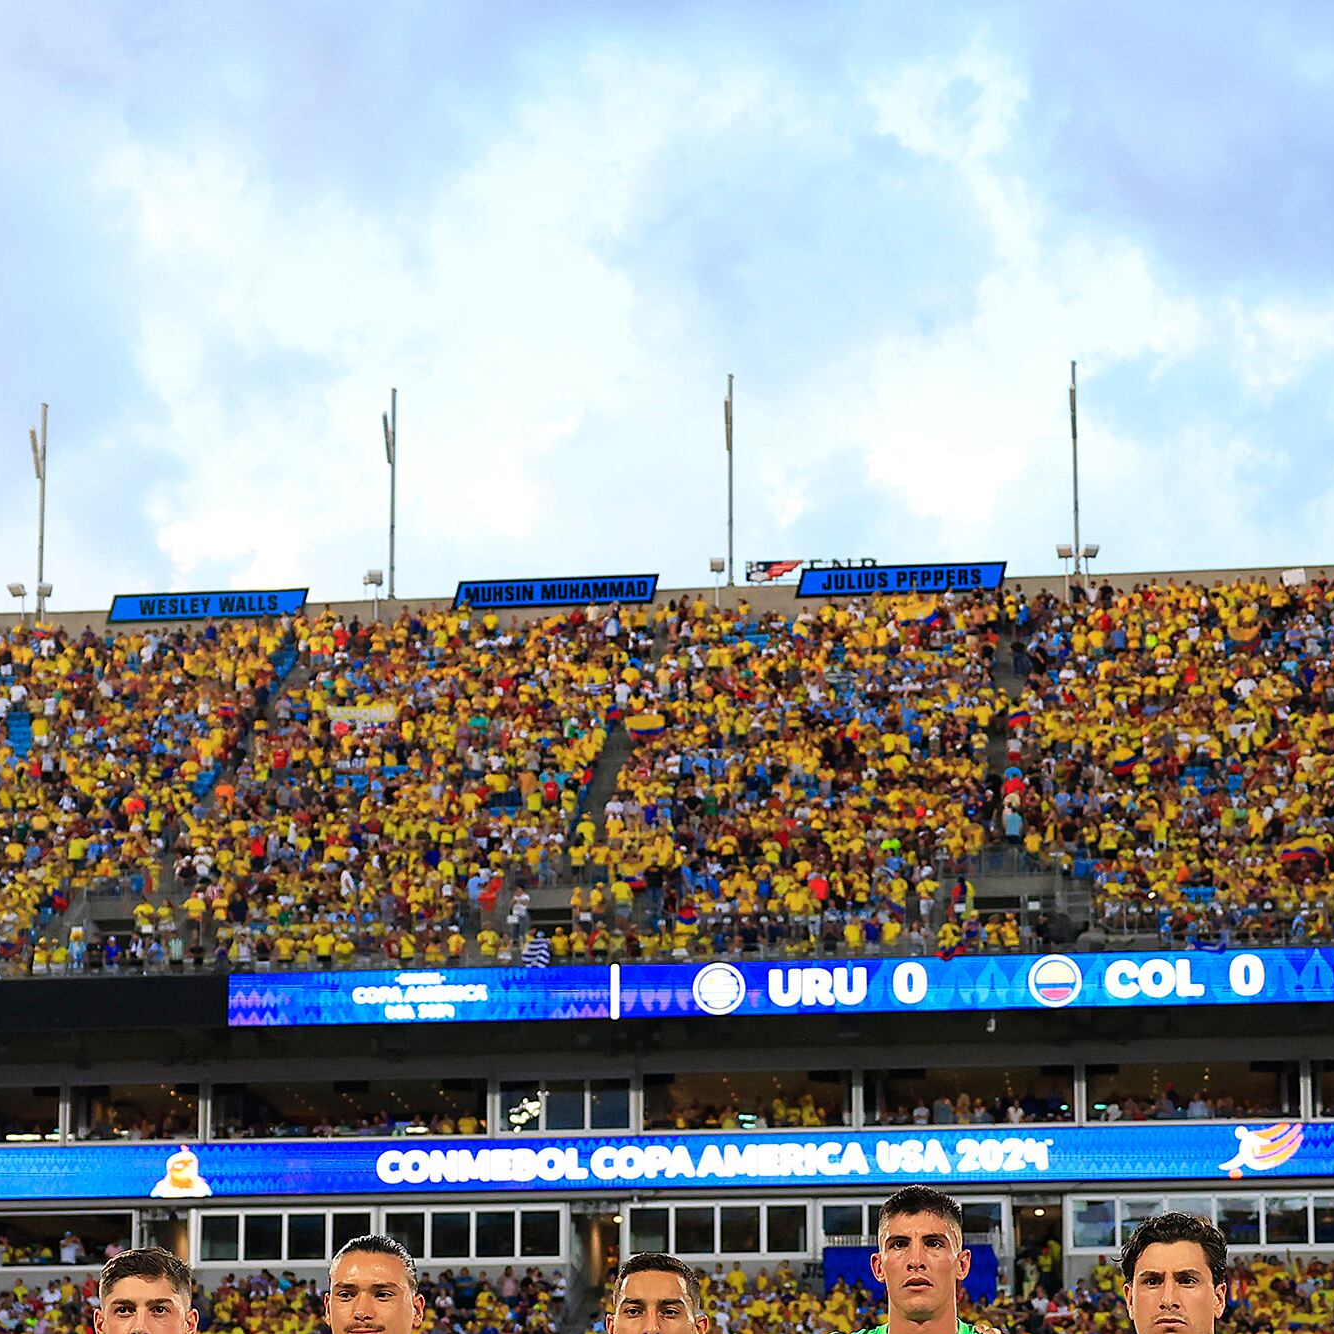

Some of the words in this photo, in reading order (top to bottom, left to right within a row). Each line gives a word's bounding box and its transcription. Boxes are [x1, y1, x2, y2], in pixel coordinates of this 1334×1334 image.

[464, 584, 535, 602] MUHSIN
[540, 579, 648, 600] MUHAMMAD
[821, 570, 889, 591] JULIUS
[896, 568, 982, 589] PEPPERS
[139, 597, 210, 616] WESLEY
[218, 594, 278, 613] WALLS
[767, 966, 868, 1007] URU
[892, 961, 928, 1004] 0
[1104, 957, 1205, 998] COL
[1228, 953, 1266, 996] 0
[352, 984, 403, 1004] COPA
[403, 983, 488, 1003] AMERICA
[375, 1147, 590, 1183] CONMEBOL
[589, 1145, 698, 1181] COPA
[696, 1140, 870, 1177] AMERICA
[875, 1139, 953, 1174] USA
[955, 1137, 1049, 1172] 2024
